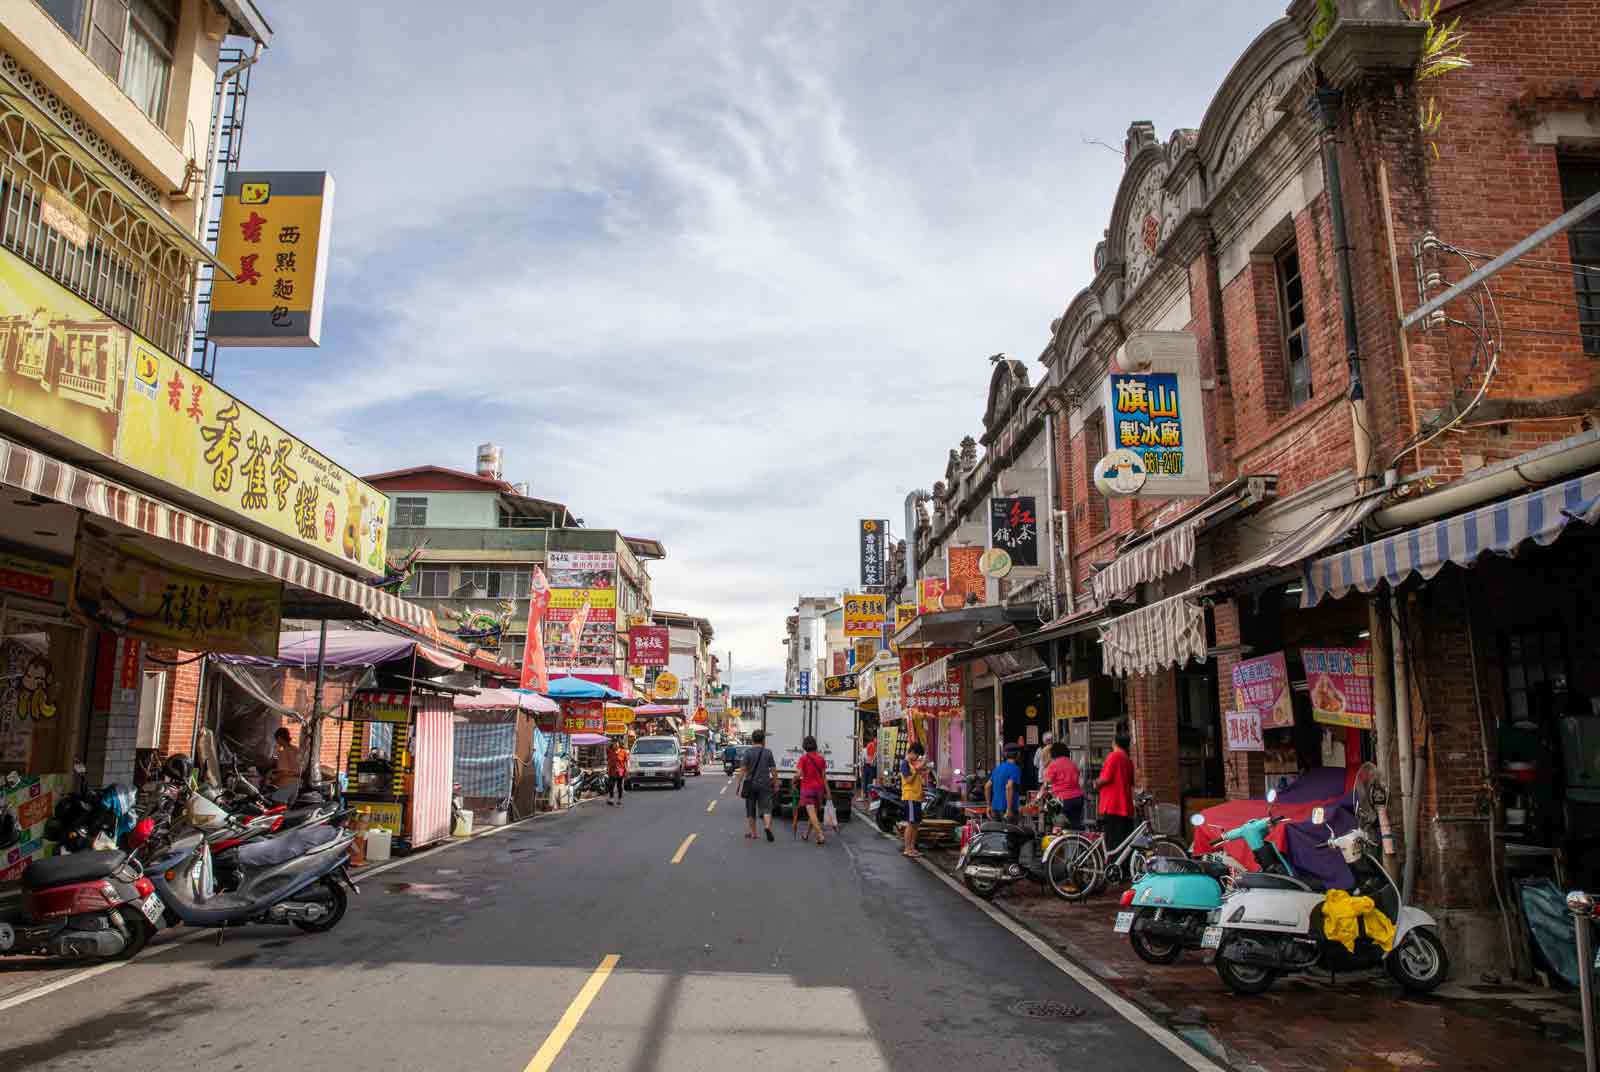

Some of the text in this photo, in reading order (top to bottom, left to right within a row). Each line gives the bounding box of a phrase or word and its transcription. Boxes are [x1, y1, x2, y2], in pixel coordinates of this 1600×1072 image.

[271, 225, 302, 328] 西點麵包
[1116, 378, 1179, 419] 旗山
[1120, 420, 1181, 447] 製冰廠
[200, 400, 319, 541] 香蕉蛋糕
[1143, 450, 1183, 475] 661-2107
